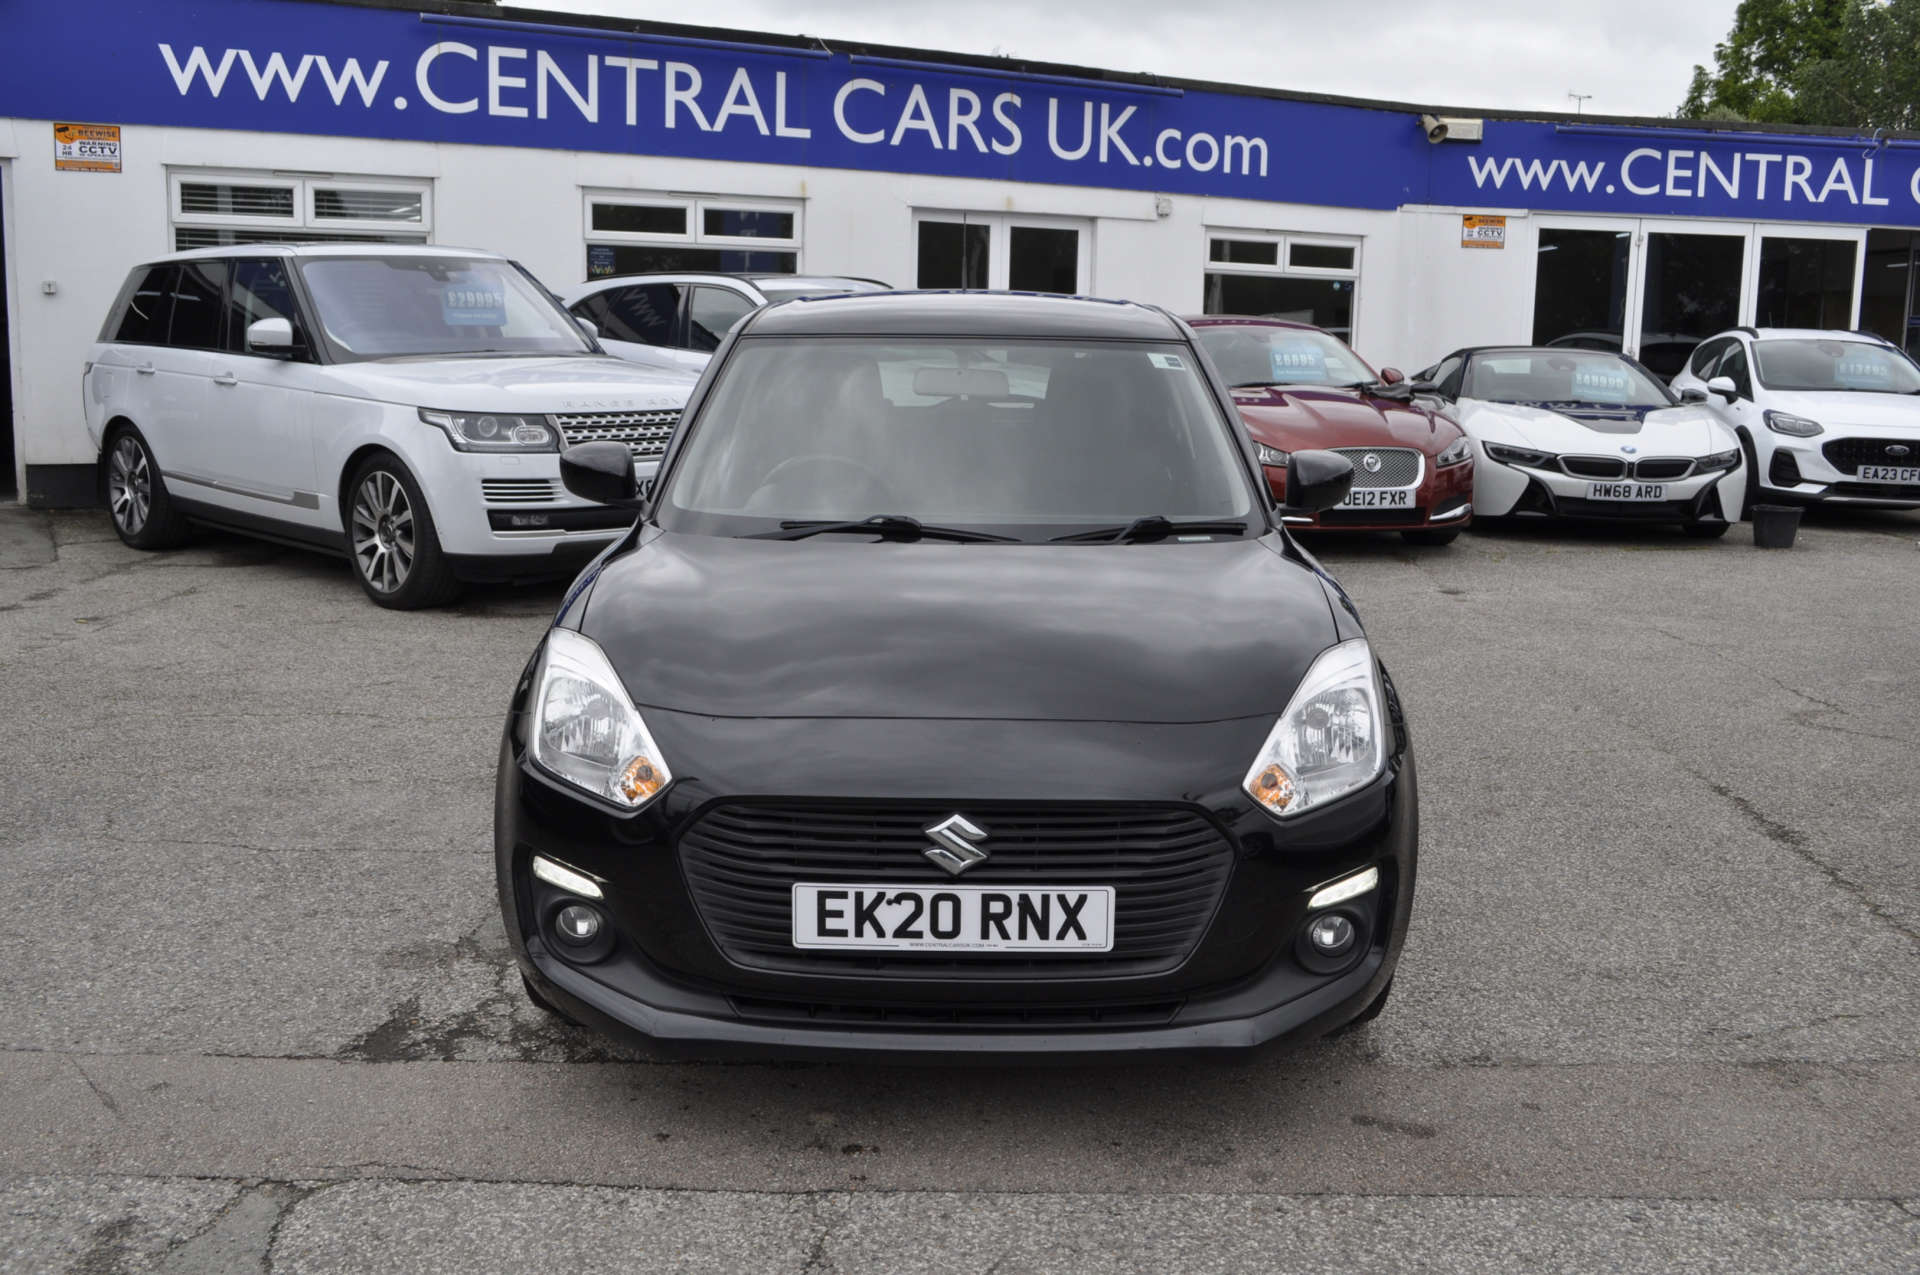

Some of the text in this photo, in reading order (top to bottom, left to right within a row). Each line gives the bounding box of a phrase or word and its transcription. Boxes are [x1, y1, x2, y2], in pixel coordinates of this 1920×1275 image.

[158, 41, 1268, 177] www.CENTRAL CARS UK.com
[79, 146, 117, 154] CCTV
[1468, 148, 1889, 206] www.CENTRAL
[1862, 467, 1920, 481] EA23 CF
[1379, 491, 1407, 505] FXR
[1592, 484, 1663, 498] HW68 ARD
[816, 889, 1089, 942] EK20 RNX
